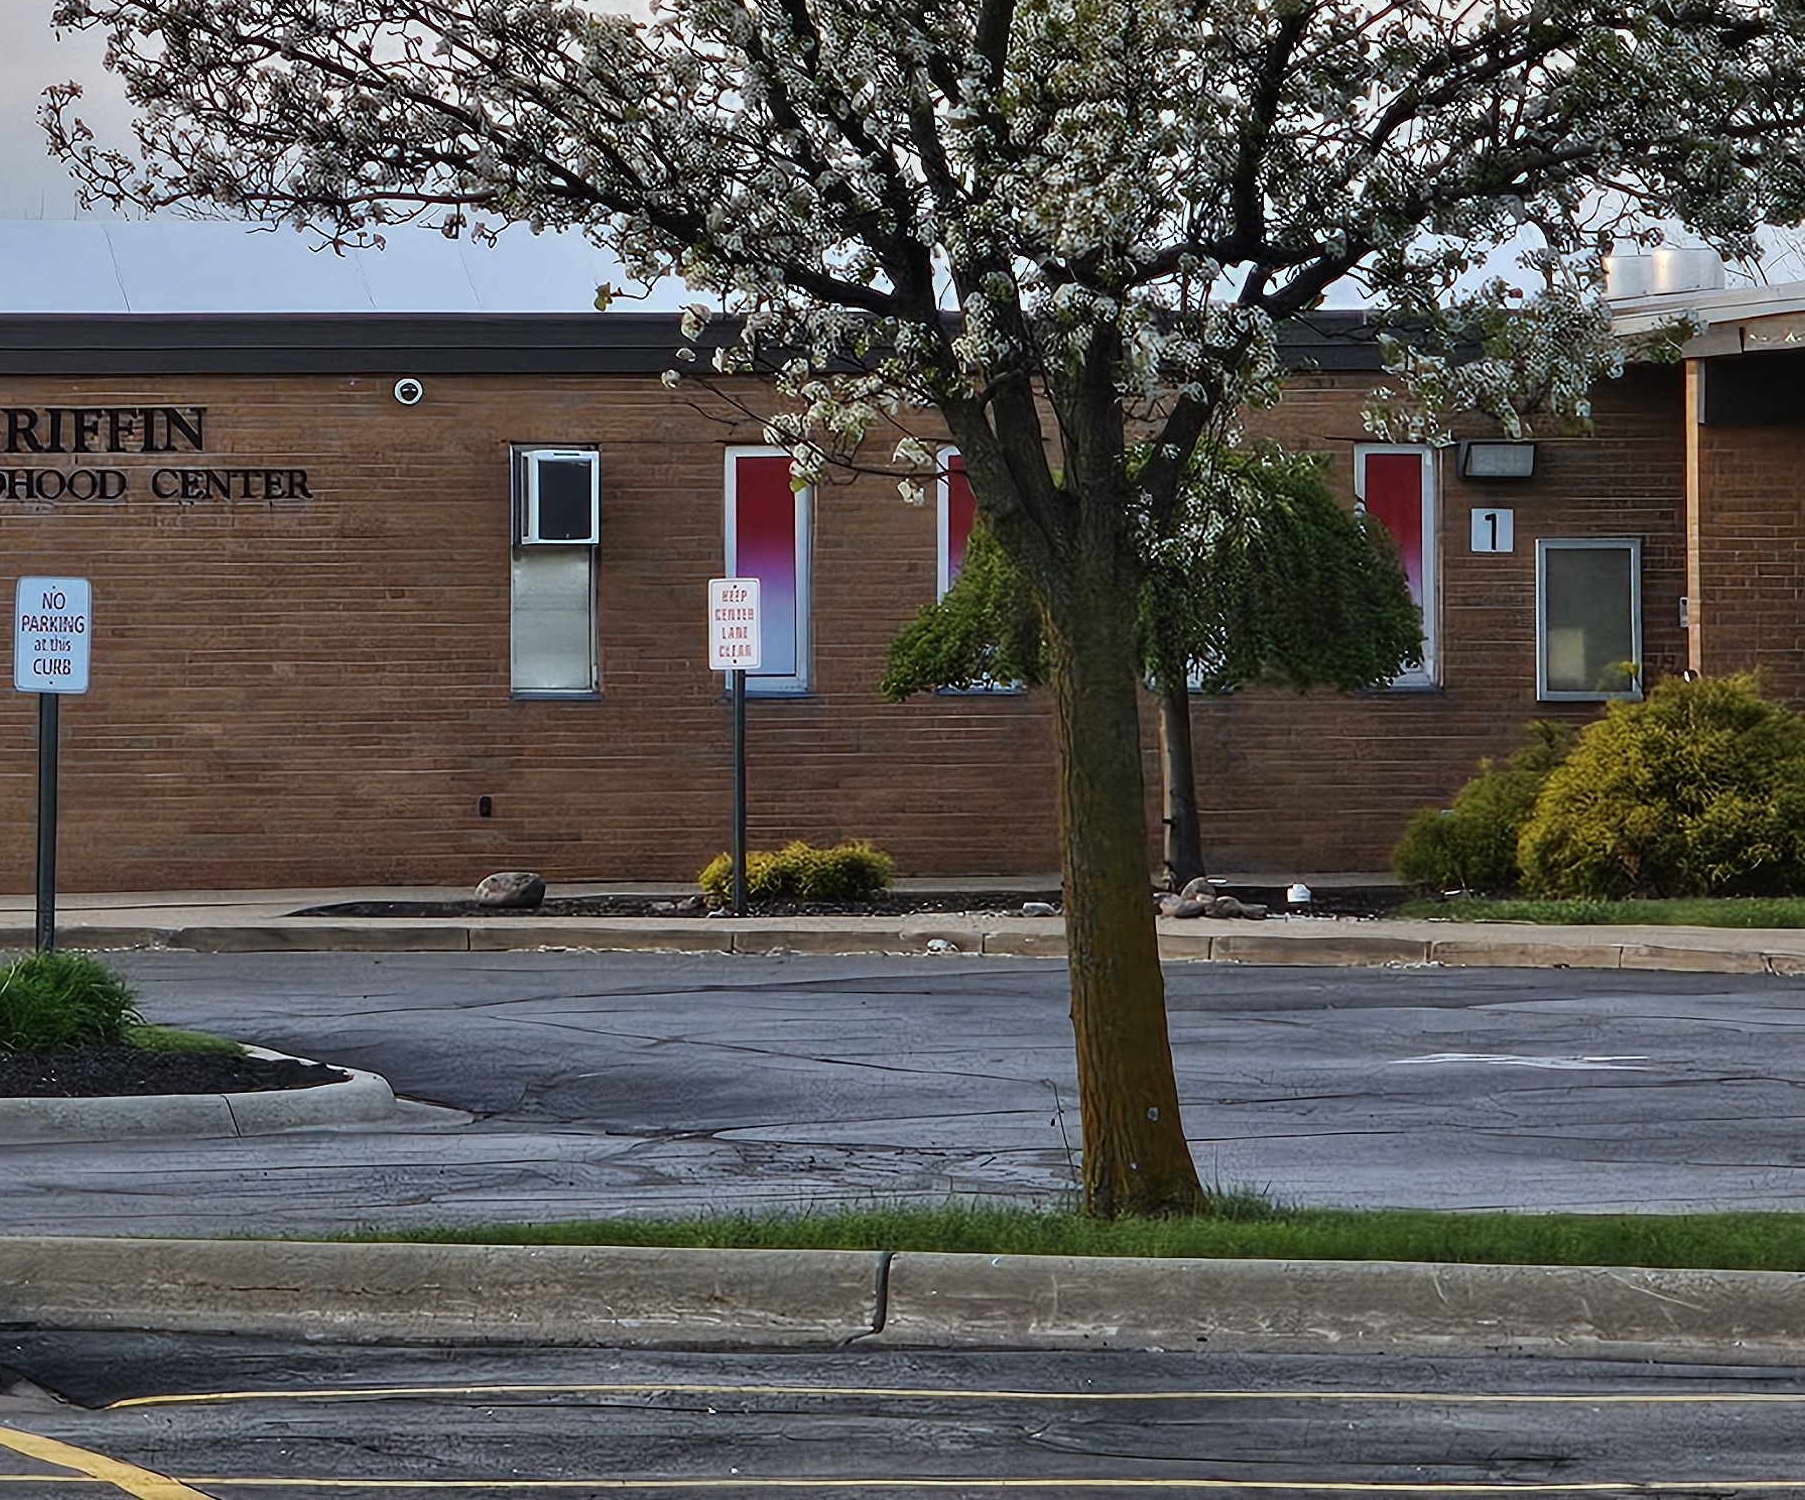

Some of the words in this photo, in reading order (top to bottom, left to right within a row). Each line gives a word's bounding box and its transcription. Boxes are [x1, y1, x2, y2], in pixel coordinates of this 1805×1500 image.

[151, 468, 314, 500] CENTER
[1485, 512, 1497, 550] 1
[42, 592, 66, 610] NO
[722, 590, 748, 602] KEEP
[21, 615, 85, 633] PARKING
[722, 626, 748, 639] LANE
[34, 639, 47, 652] at
[50, 637, 71, 652] this
[719, 644, 752, 657] CLEAR
[33, 658, 71, 675] CURB
